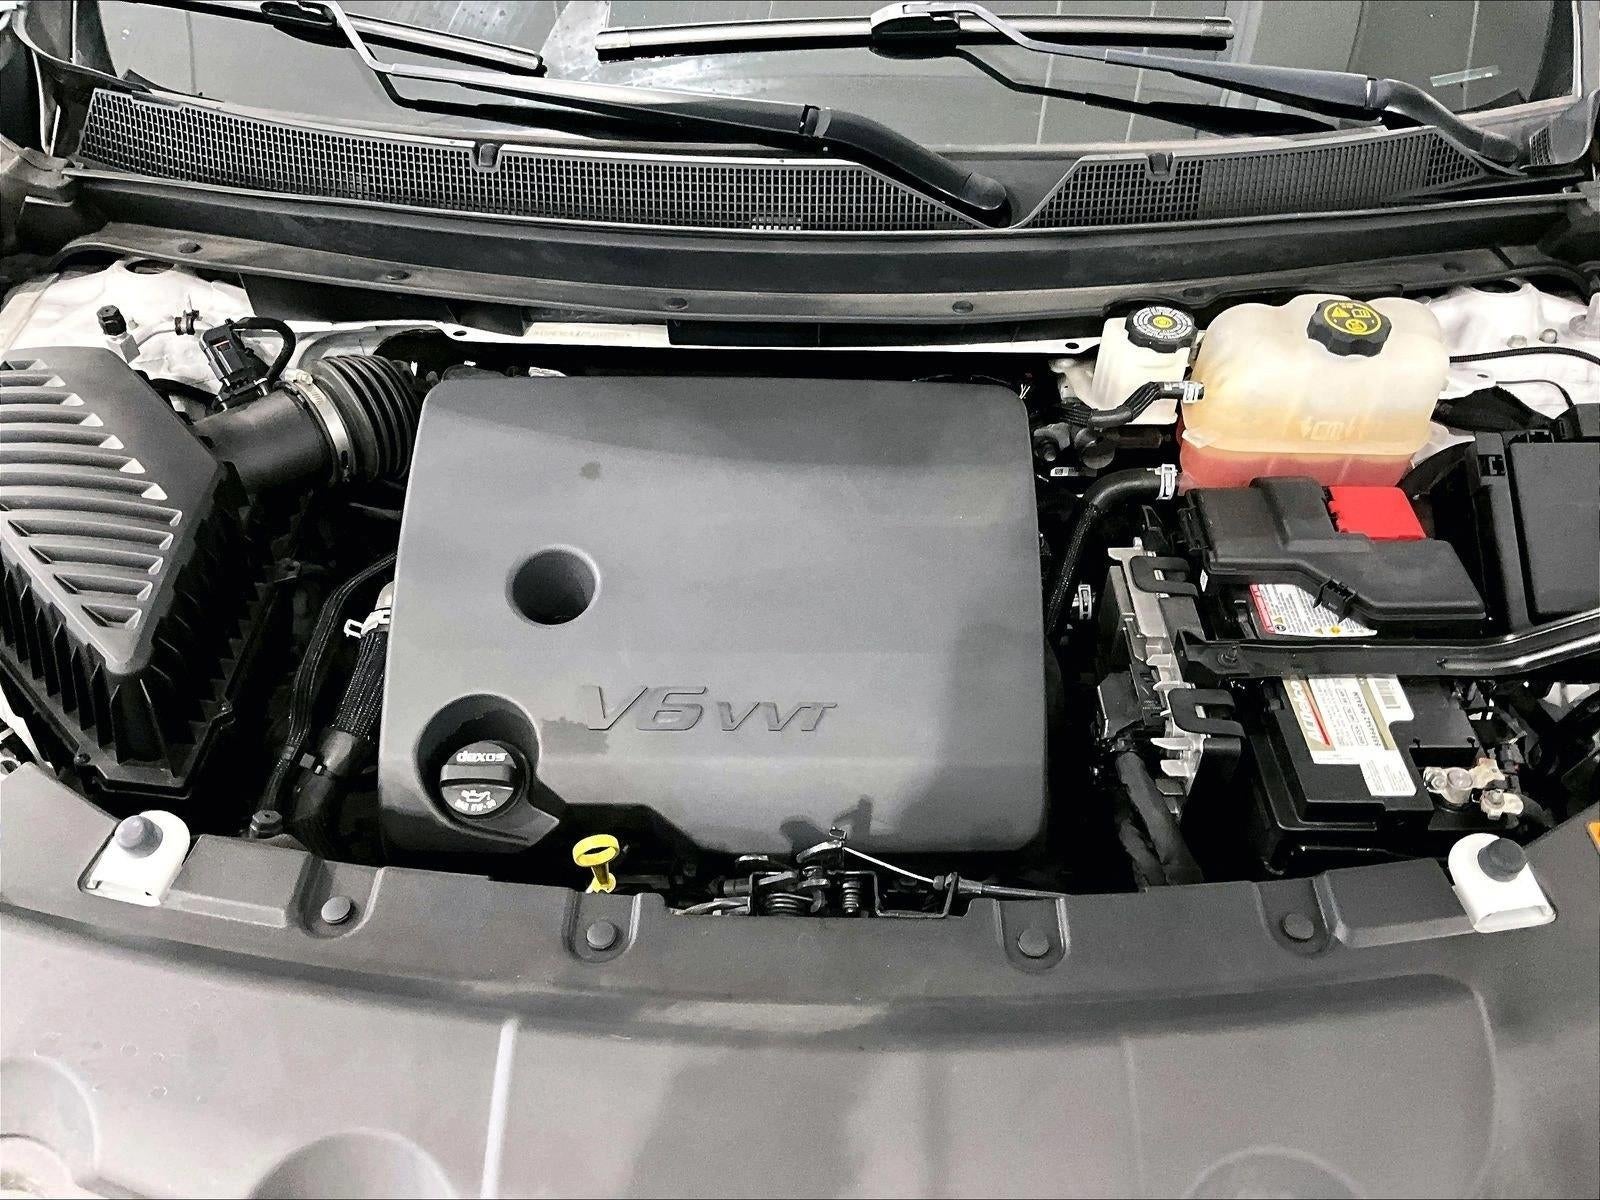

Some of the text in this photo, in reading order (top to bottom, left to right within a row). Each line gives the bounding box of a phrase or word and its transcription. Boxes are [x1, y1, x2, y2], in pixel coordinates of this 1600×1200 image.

[581, 686, 838, 731] V6 VVT
[456, 750, 508, 762] dexos
